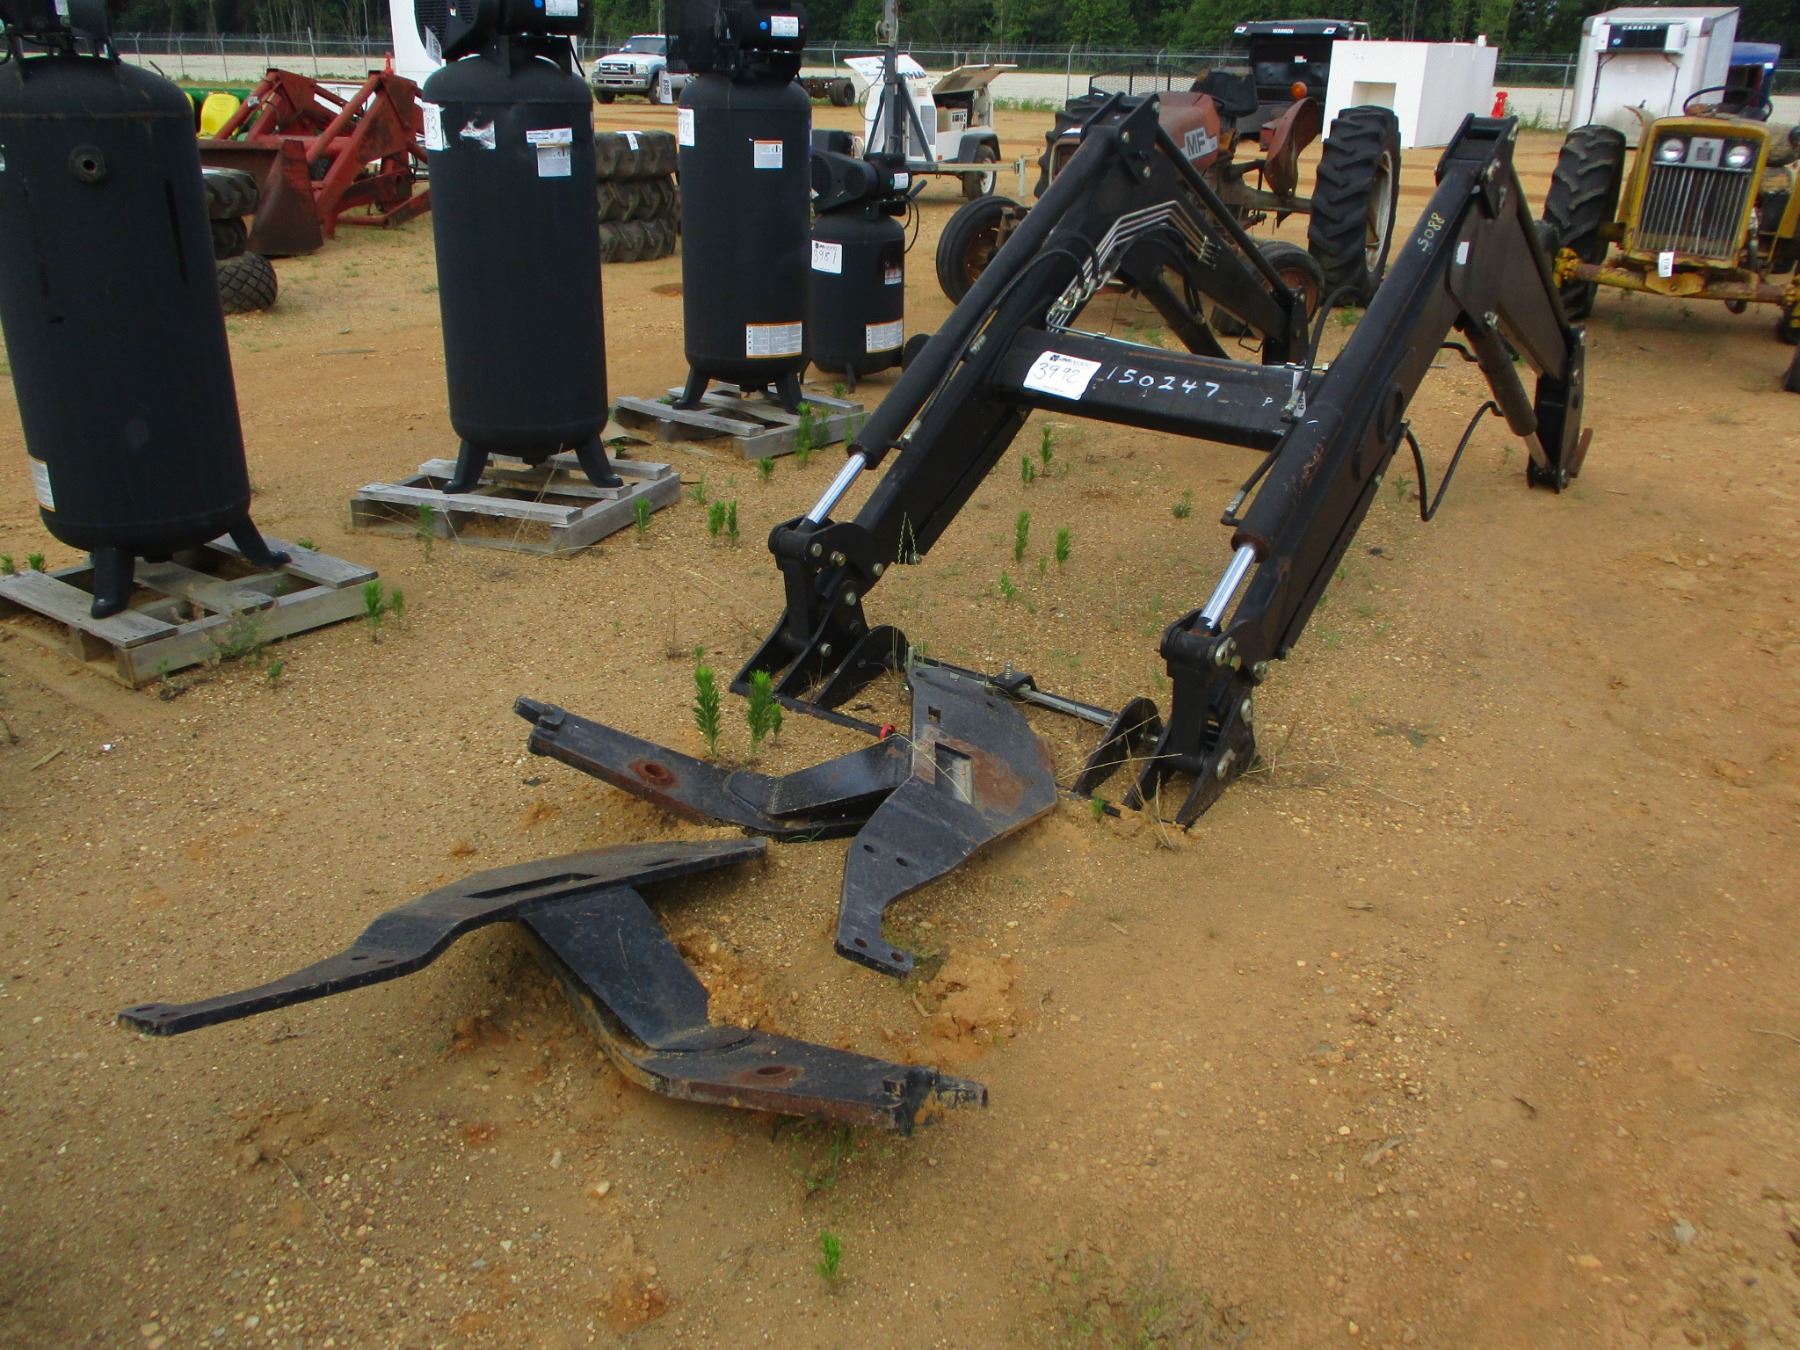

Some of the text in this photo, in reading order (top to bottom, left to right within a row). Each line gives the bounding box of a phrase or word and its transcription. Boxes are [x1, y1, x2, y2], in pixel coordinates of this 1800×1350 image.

[1186, 131, 1206, 157] MF
[1417, 211, 1445, 252] 5088
[813, 248, 838, 265] 3981
[1032, 362, 1081, 384] 3992
[1106, 365, 1221, 399] 150247
